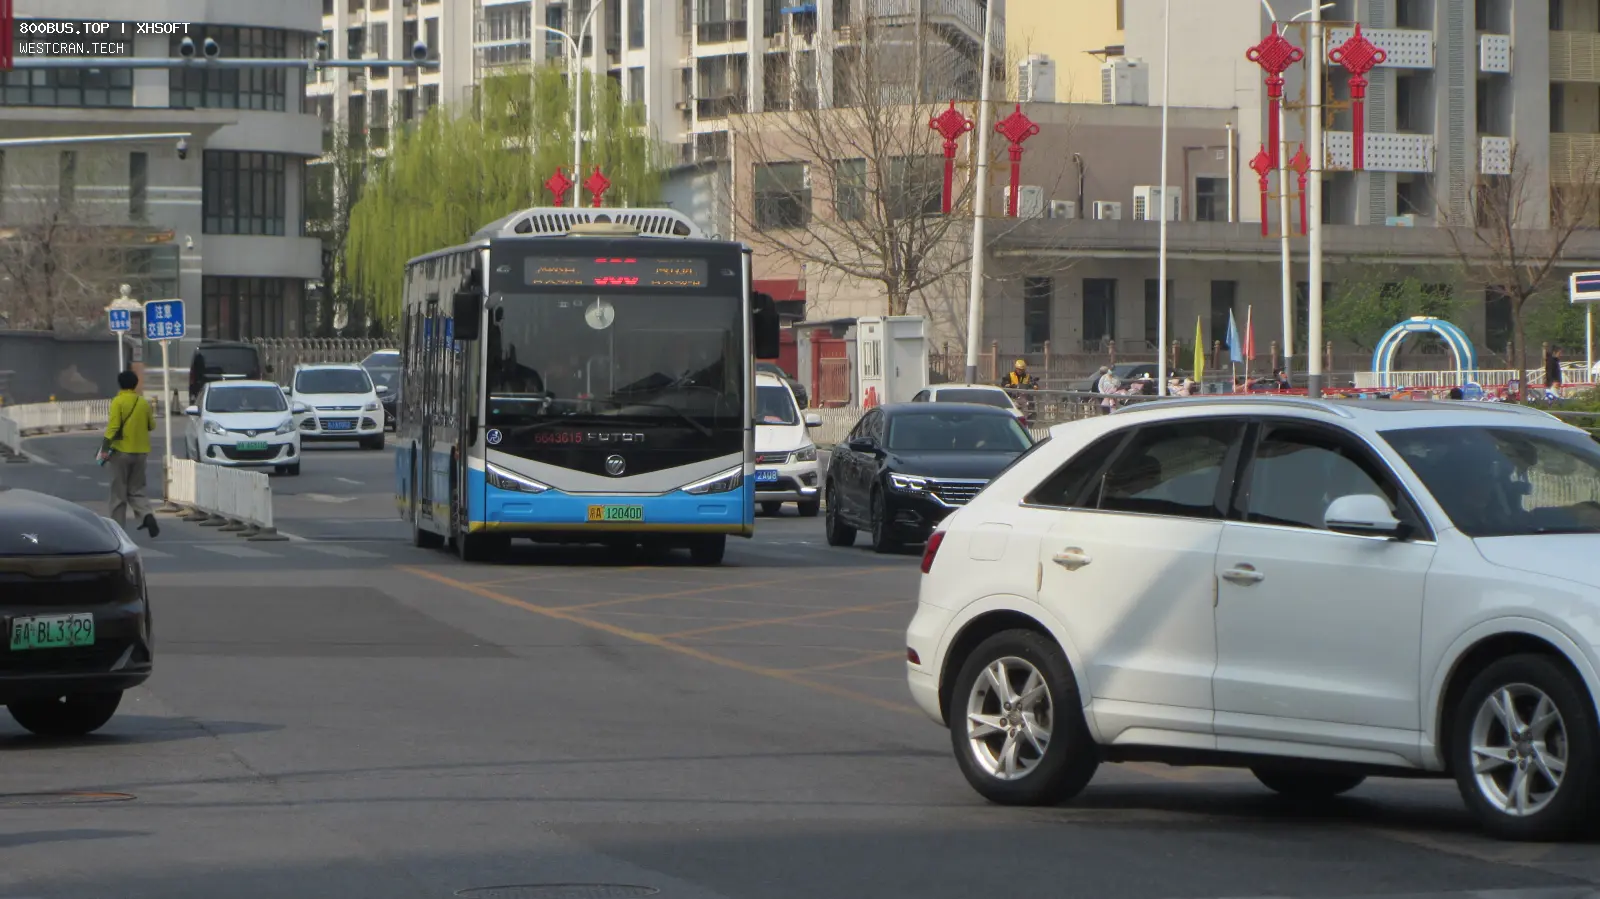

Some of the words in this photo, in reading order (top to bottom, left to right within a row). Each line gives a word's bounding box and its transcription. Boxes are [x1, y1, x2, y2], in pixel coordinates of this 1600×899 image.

[155, 304, 172, 319] 注意
[148, 321, 182, 337] 交通安全
